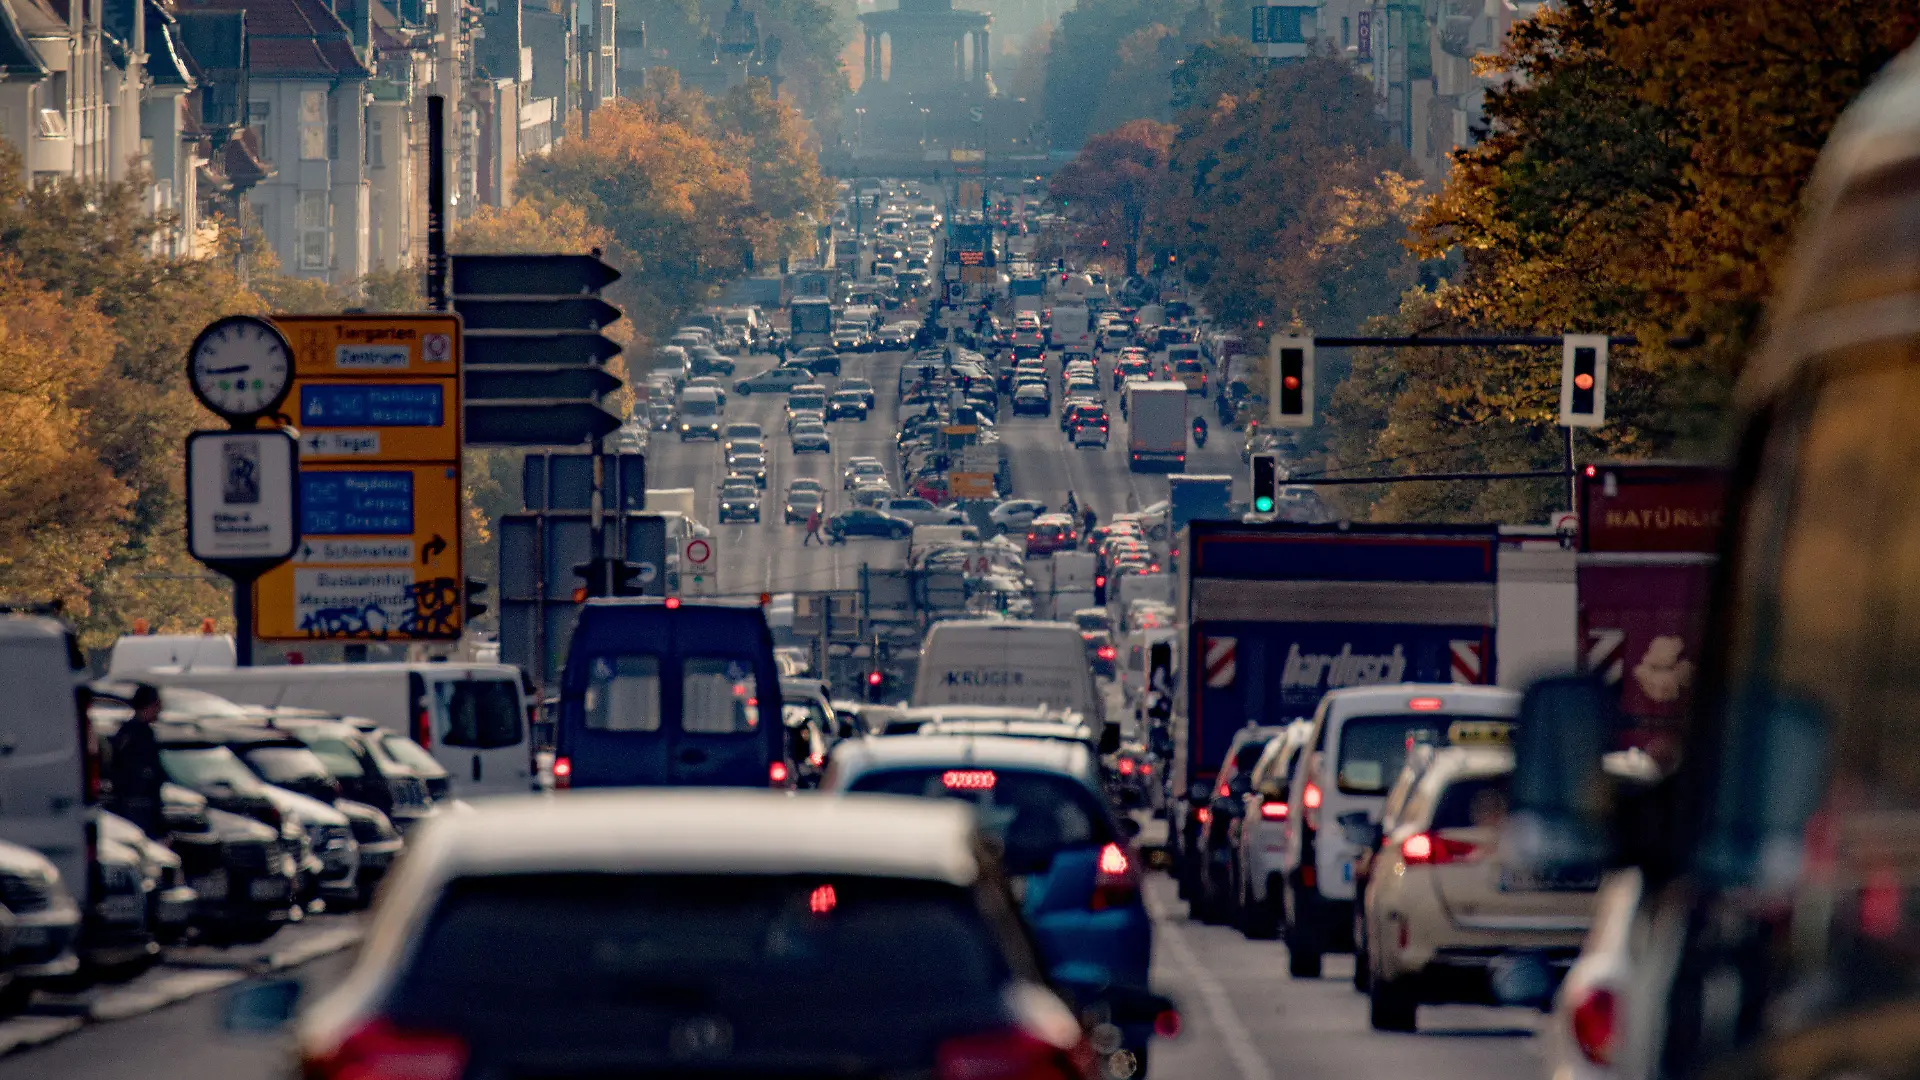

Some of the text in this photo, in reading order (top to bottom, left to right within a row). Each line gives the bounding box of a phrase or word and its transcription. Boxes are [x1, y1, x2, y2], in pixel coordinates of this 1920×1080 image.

[969, 105, 983, 122] S
[335, 325, 416, 343] Tiergarten
[341, 348, 408, 364] Zentrum
[947, 669, 1023, 686] KRÜGER
